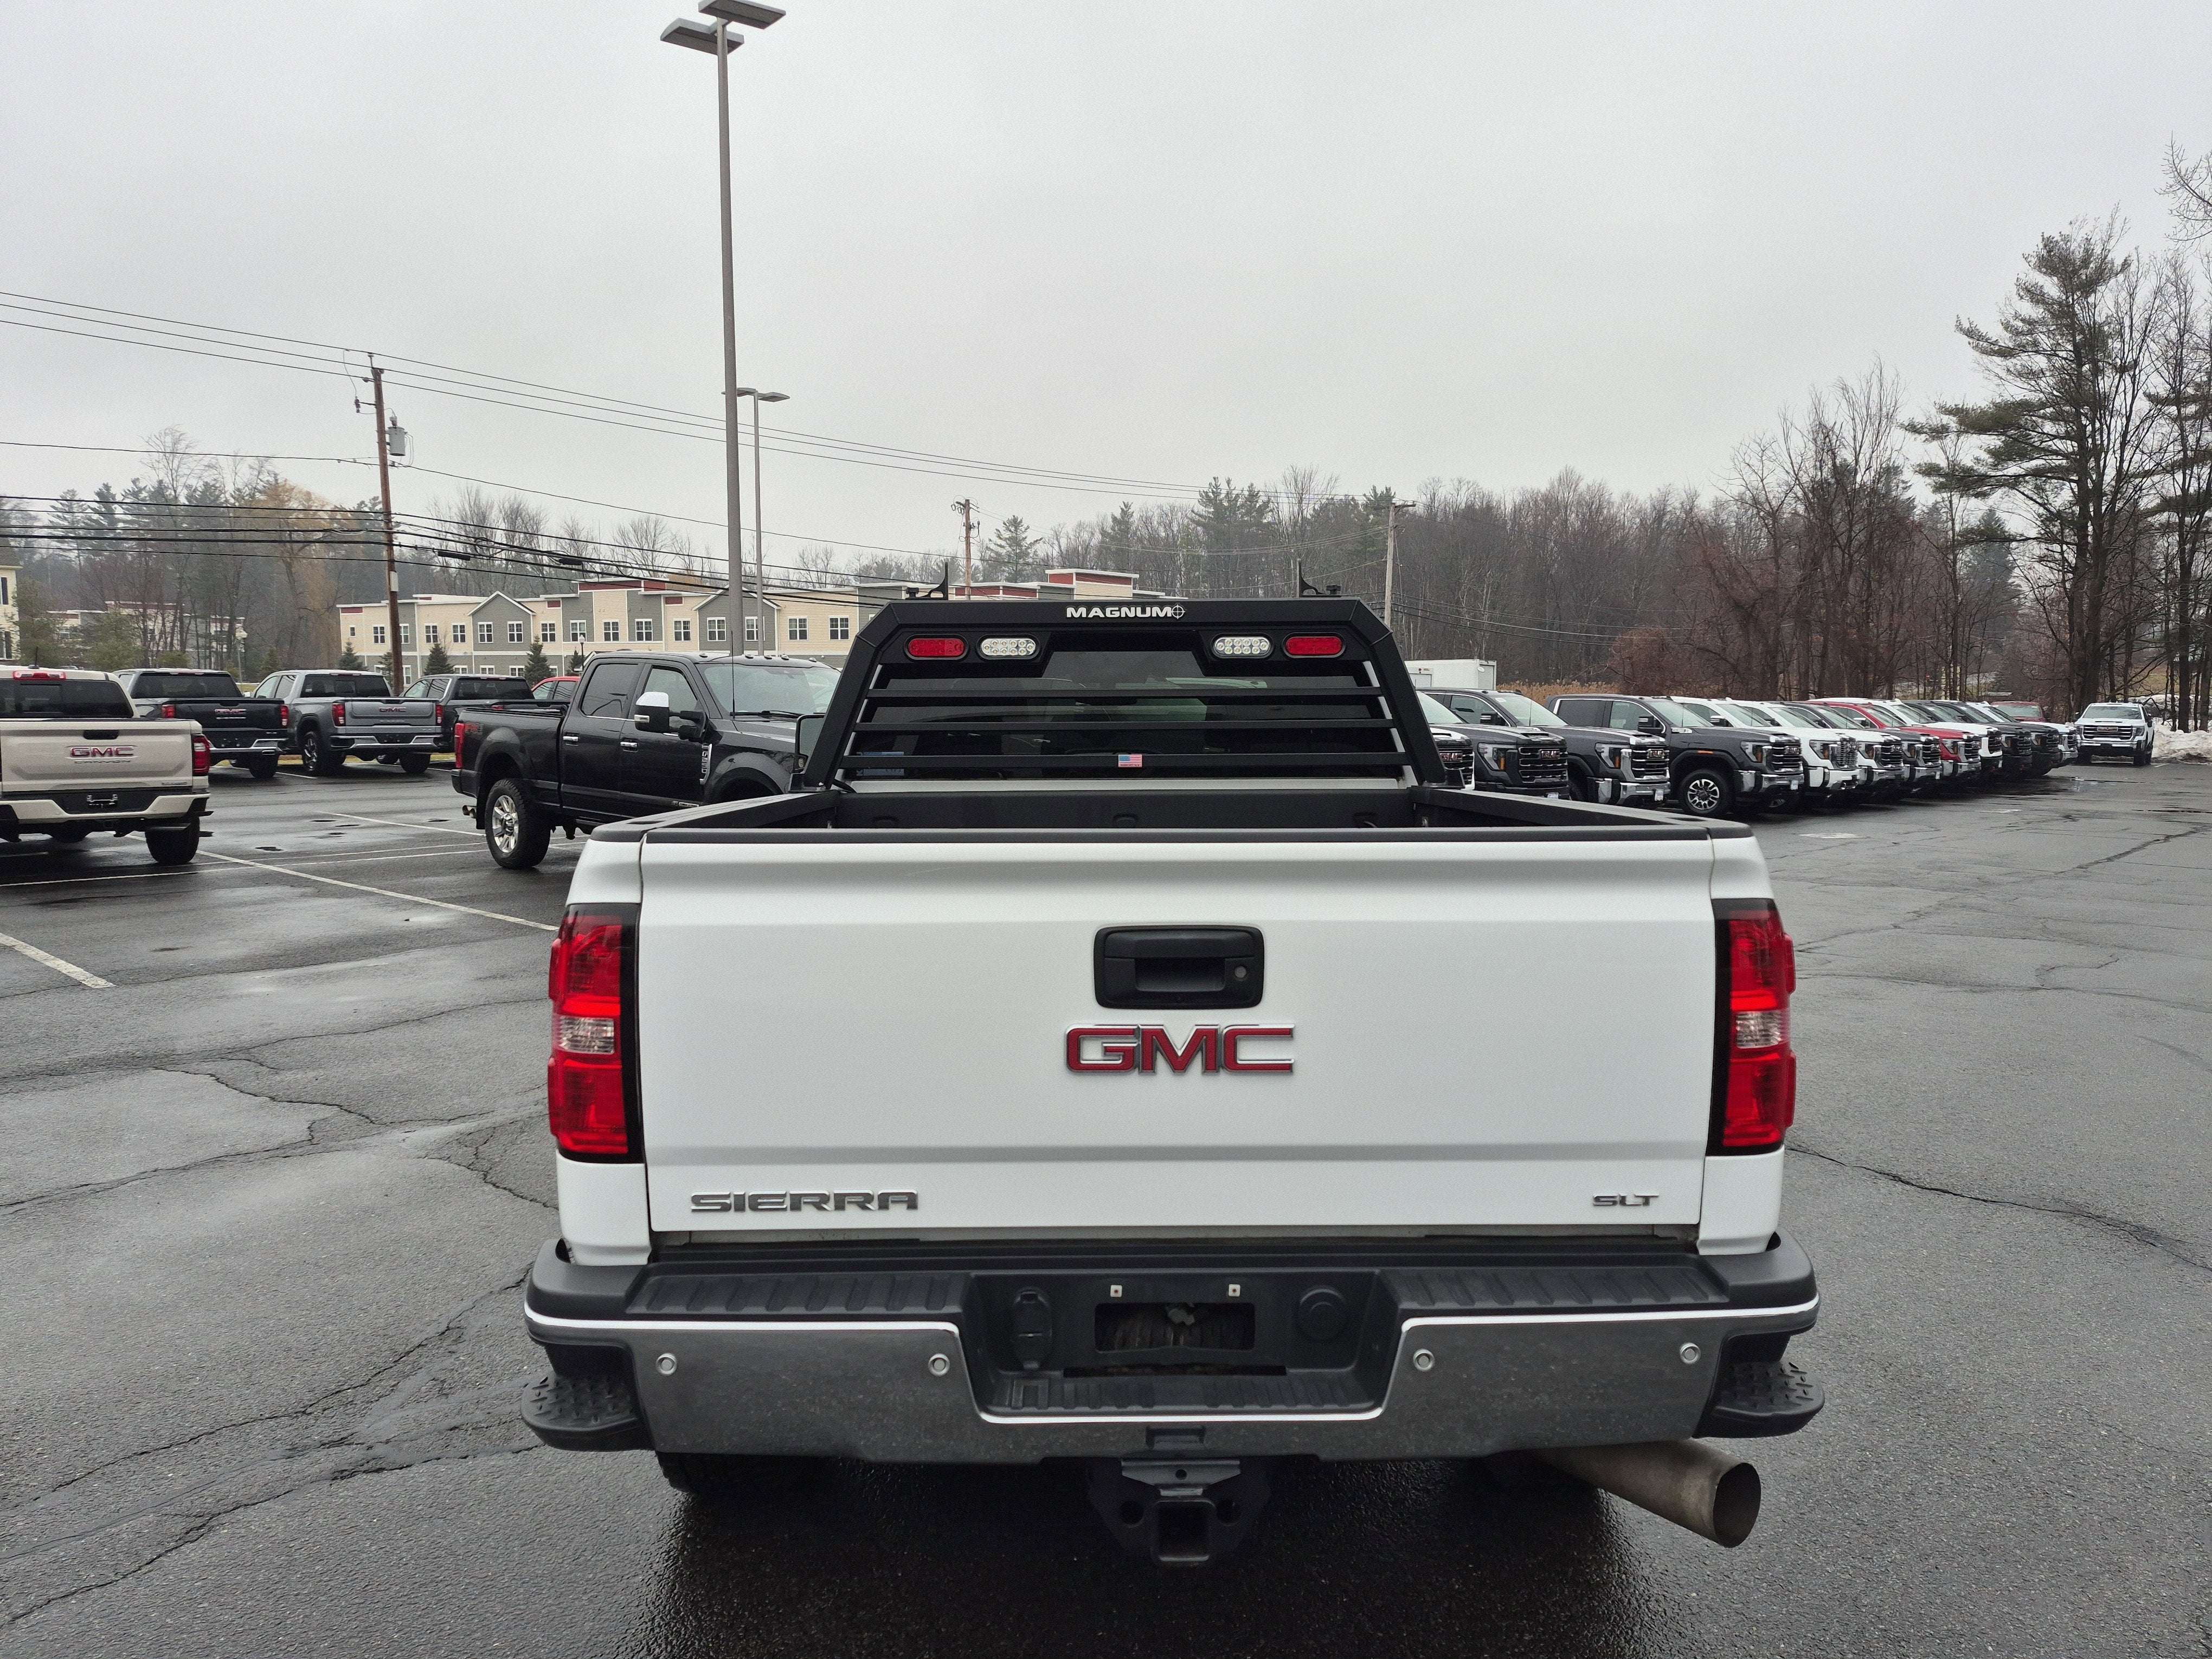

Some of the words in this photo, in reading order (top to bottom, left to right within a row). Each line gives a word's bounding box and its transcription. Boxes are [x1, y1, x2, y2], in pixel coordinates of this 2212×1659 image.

[1066, 606, 1172, 618] MAGNUM
[71, 747, 134, 757] GMC
[1065, 1024, 1295, 1073] GMC
[691, 1189, 918, 1212] SIERRA
[1592, 1193, 1660, 1206] SLT
